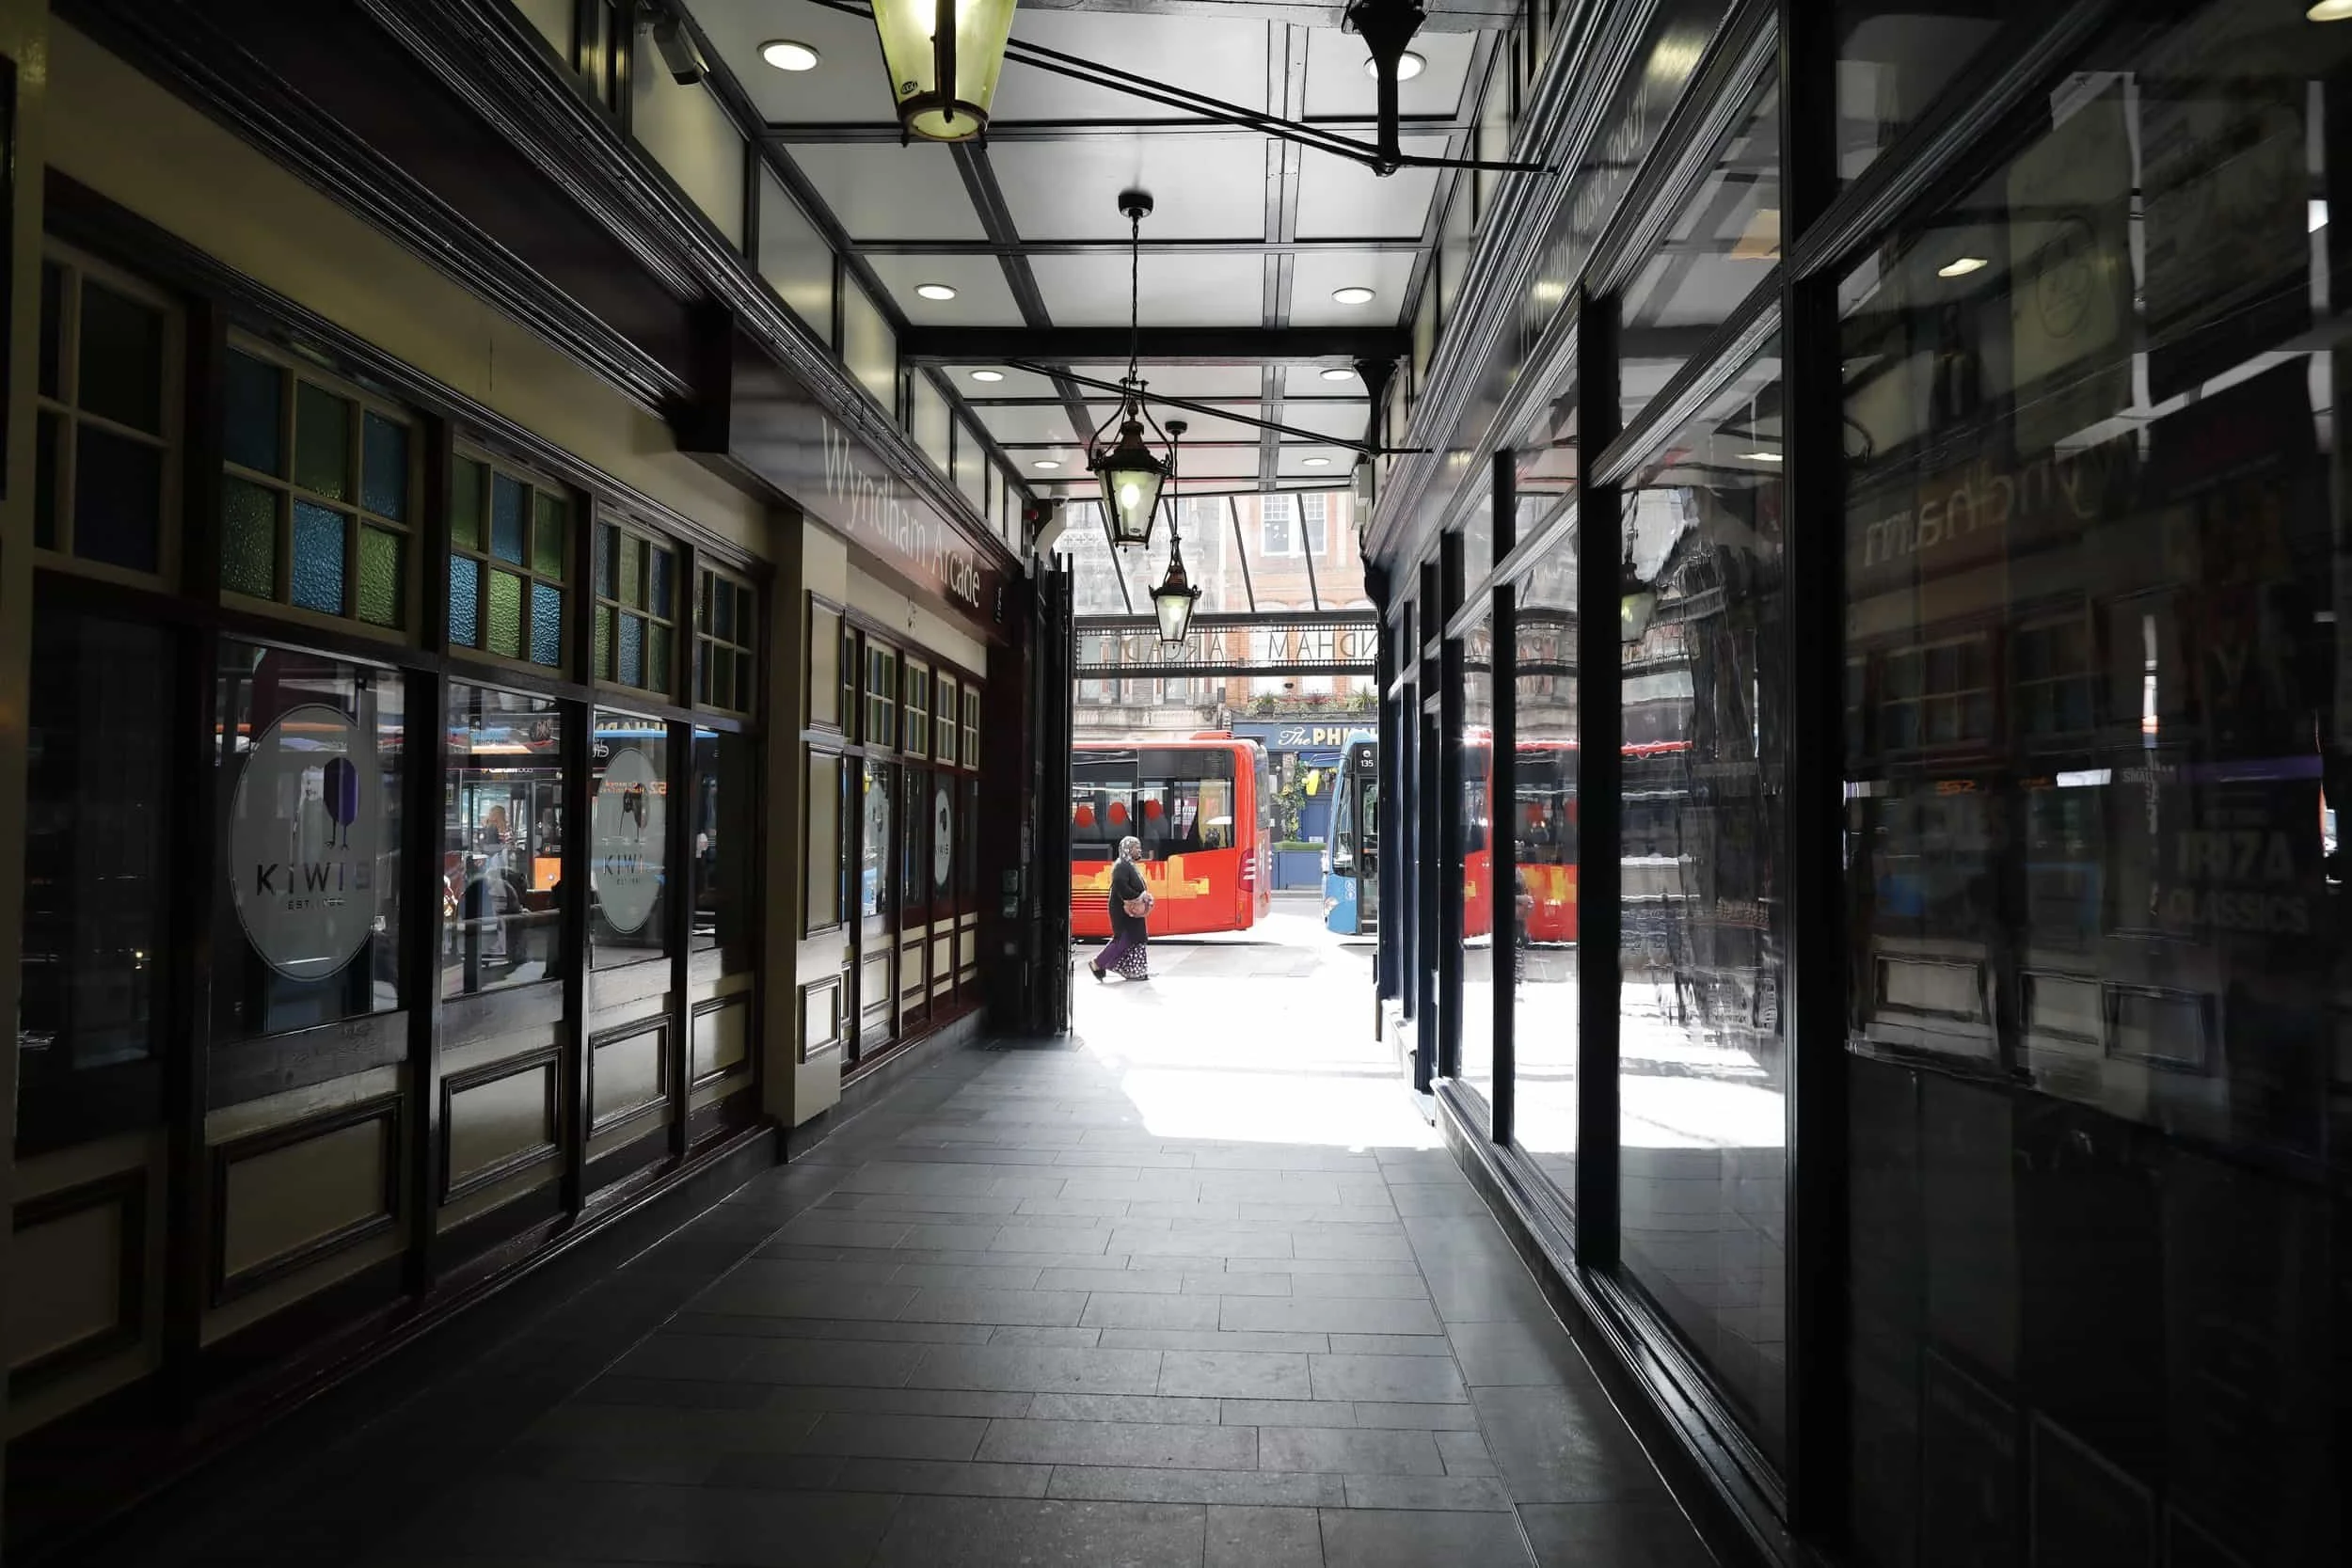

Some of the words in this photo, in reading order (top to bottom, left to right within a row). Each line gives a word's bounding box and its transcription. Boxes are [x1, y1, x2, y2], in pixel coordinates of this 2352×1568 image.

[821, 416, 926, 568] Wyndham
[931, 525, 981, 608] Arcade
[1279, 726, 1311, 746] The
[1360, 759, 1374, 768] 135
